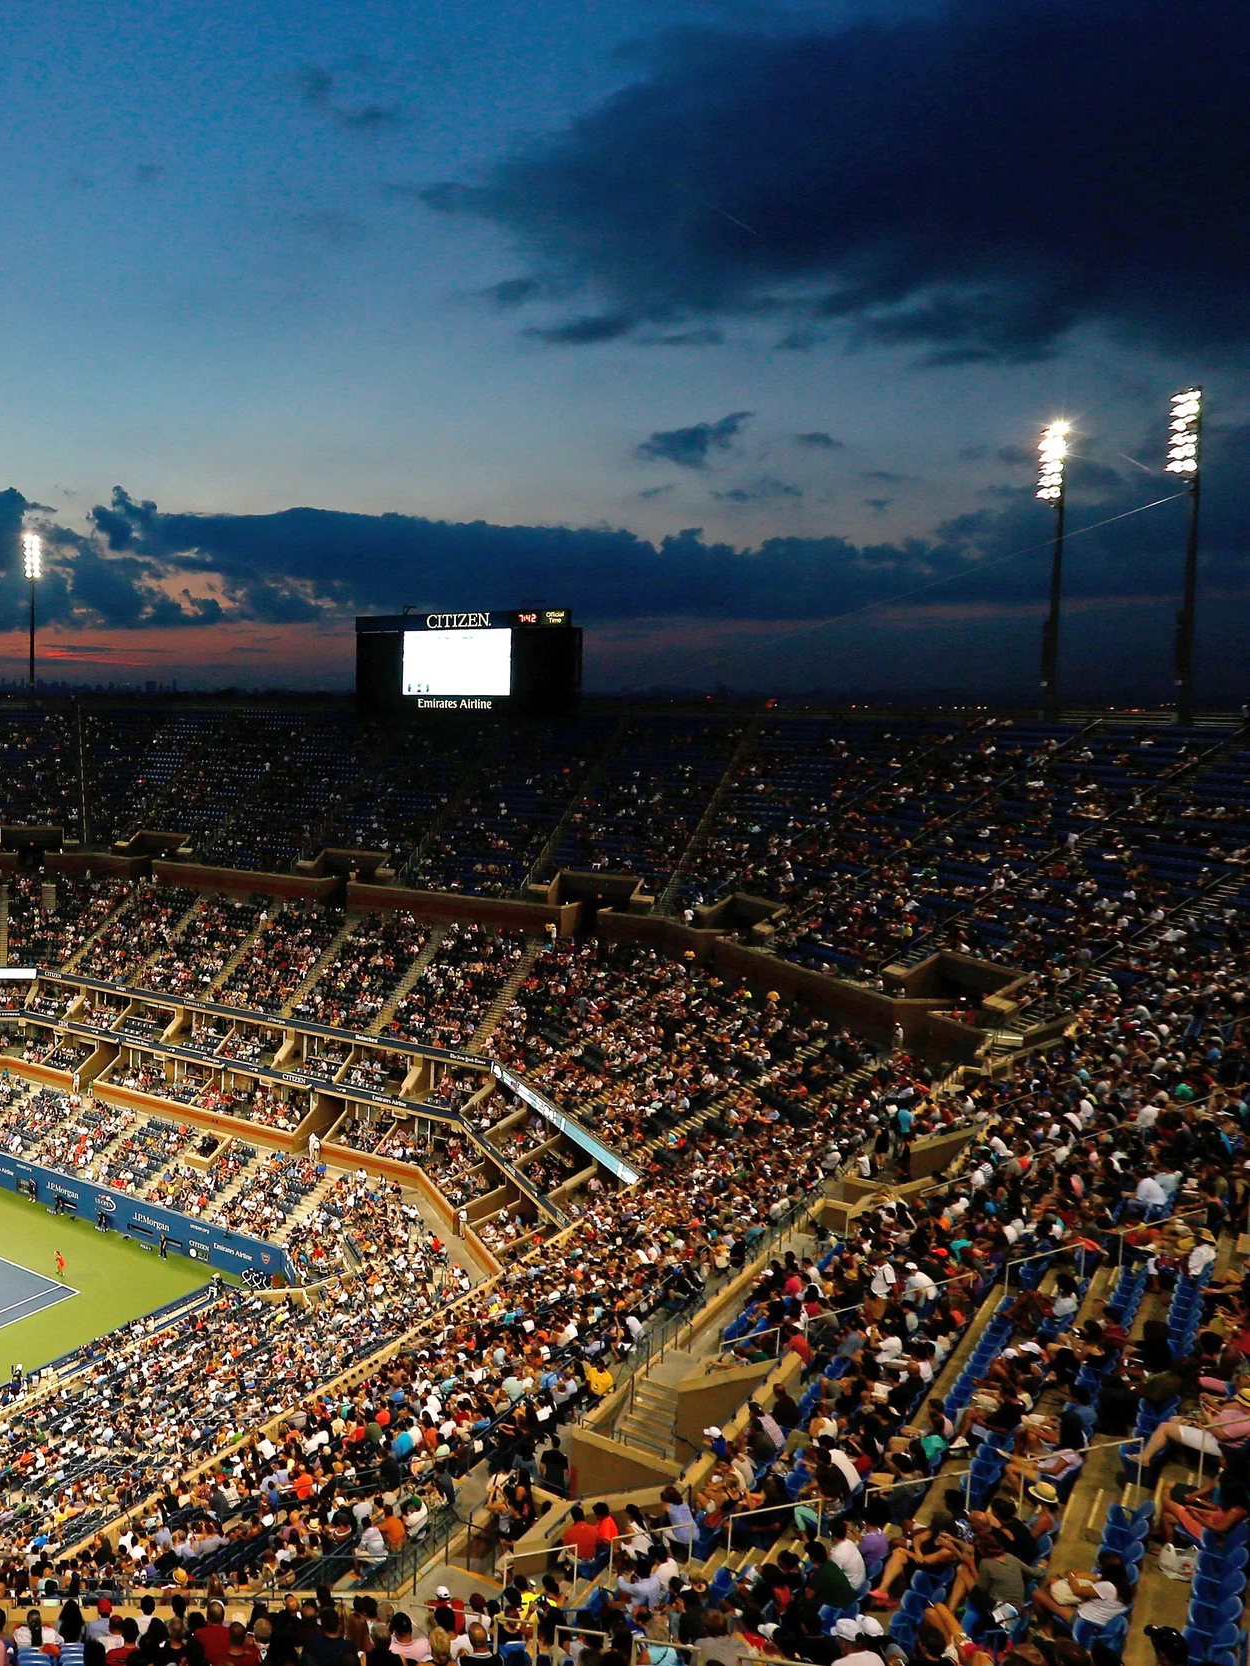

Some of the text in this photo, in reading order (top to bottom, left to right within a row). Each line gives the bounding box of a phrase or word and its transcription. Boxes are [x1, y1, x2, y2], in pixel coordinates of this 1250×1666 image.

[518, 613, 537, 623] 7:42
[417, 698, 492, 709] Emirates Airline
[45, 971, 62, 979] CITIZEN
[58, 1020, 69, 1028] IBM
[282, 1074, 306, 1084] CITIZEN
[189, 1240, 210, 1251] CITIZEN
[213, 1242, 252, 1261] Emirates Airline
